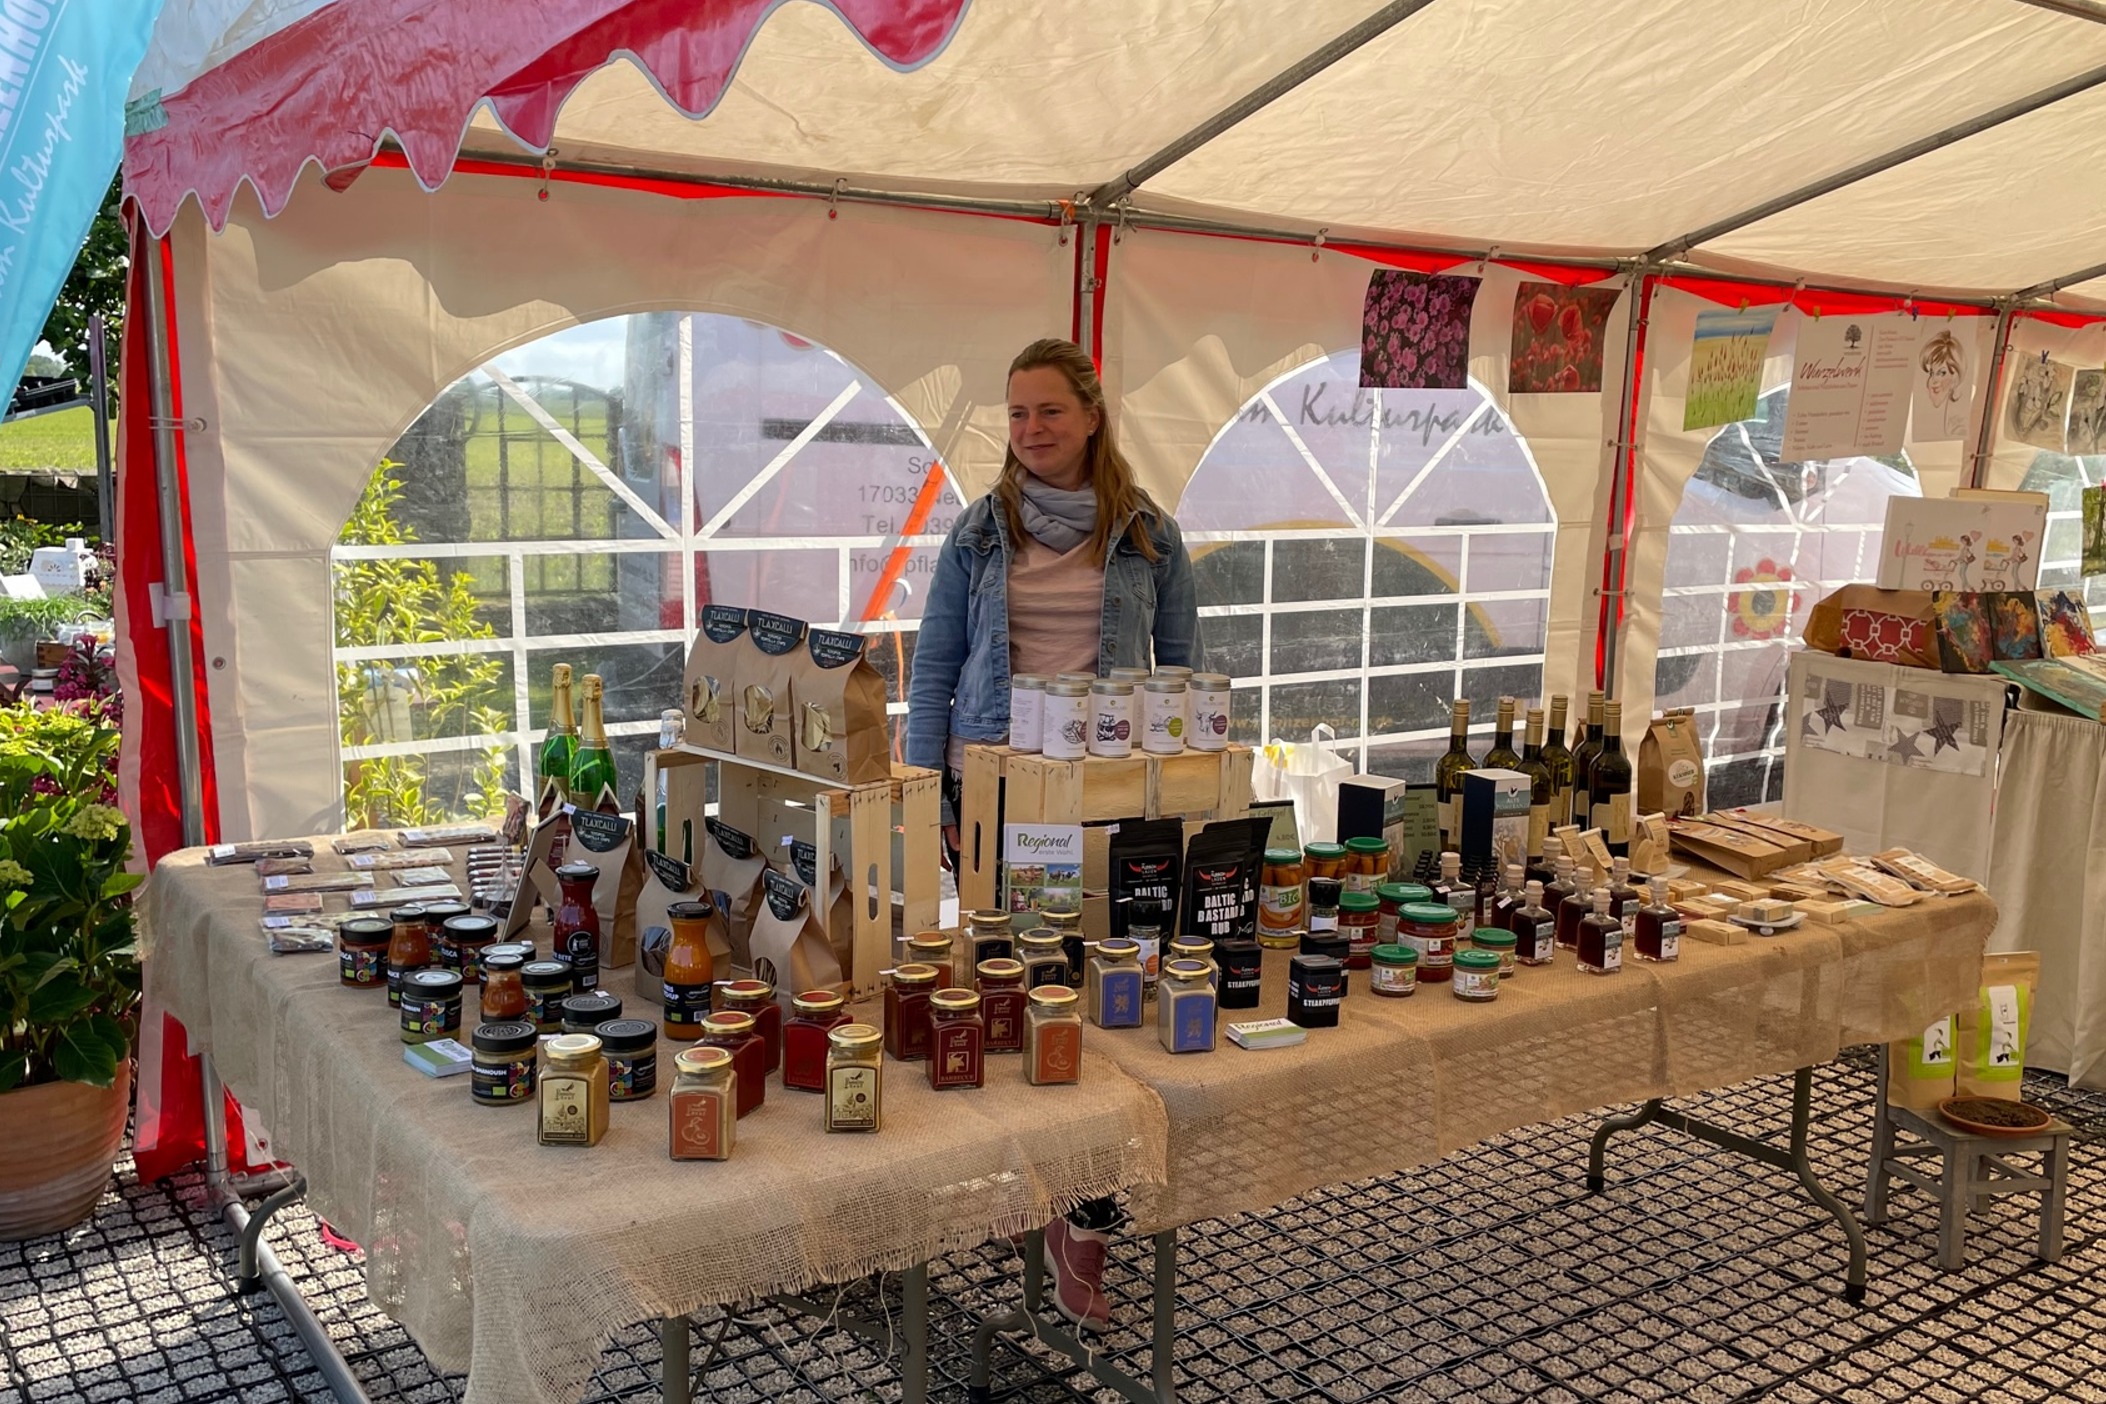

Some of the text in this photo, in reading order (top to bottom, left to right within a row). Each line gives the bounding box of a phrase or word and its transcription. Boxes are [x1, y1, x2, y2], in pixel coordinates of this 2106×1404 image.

[0, 54, 89, 235] Kulturpark
[858, 485, 919, 504] 17033
[862, 515, 900, 534] Tel.
[757, 616, 793, 634] TLAXCALLI
[818, 633, 852, 649] TLAXCALLI
[580, 816, 618, 832] TLAXCALLI
[1017, 833, 1073, 854] Regional
[1135, 886, 1168, 897] BALTIC
[1204, 893, 1236, 909] BALTIC
[1211, 921, 1230, 935] RUB
